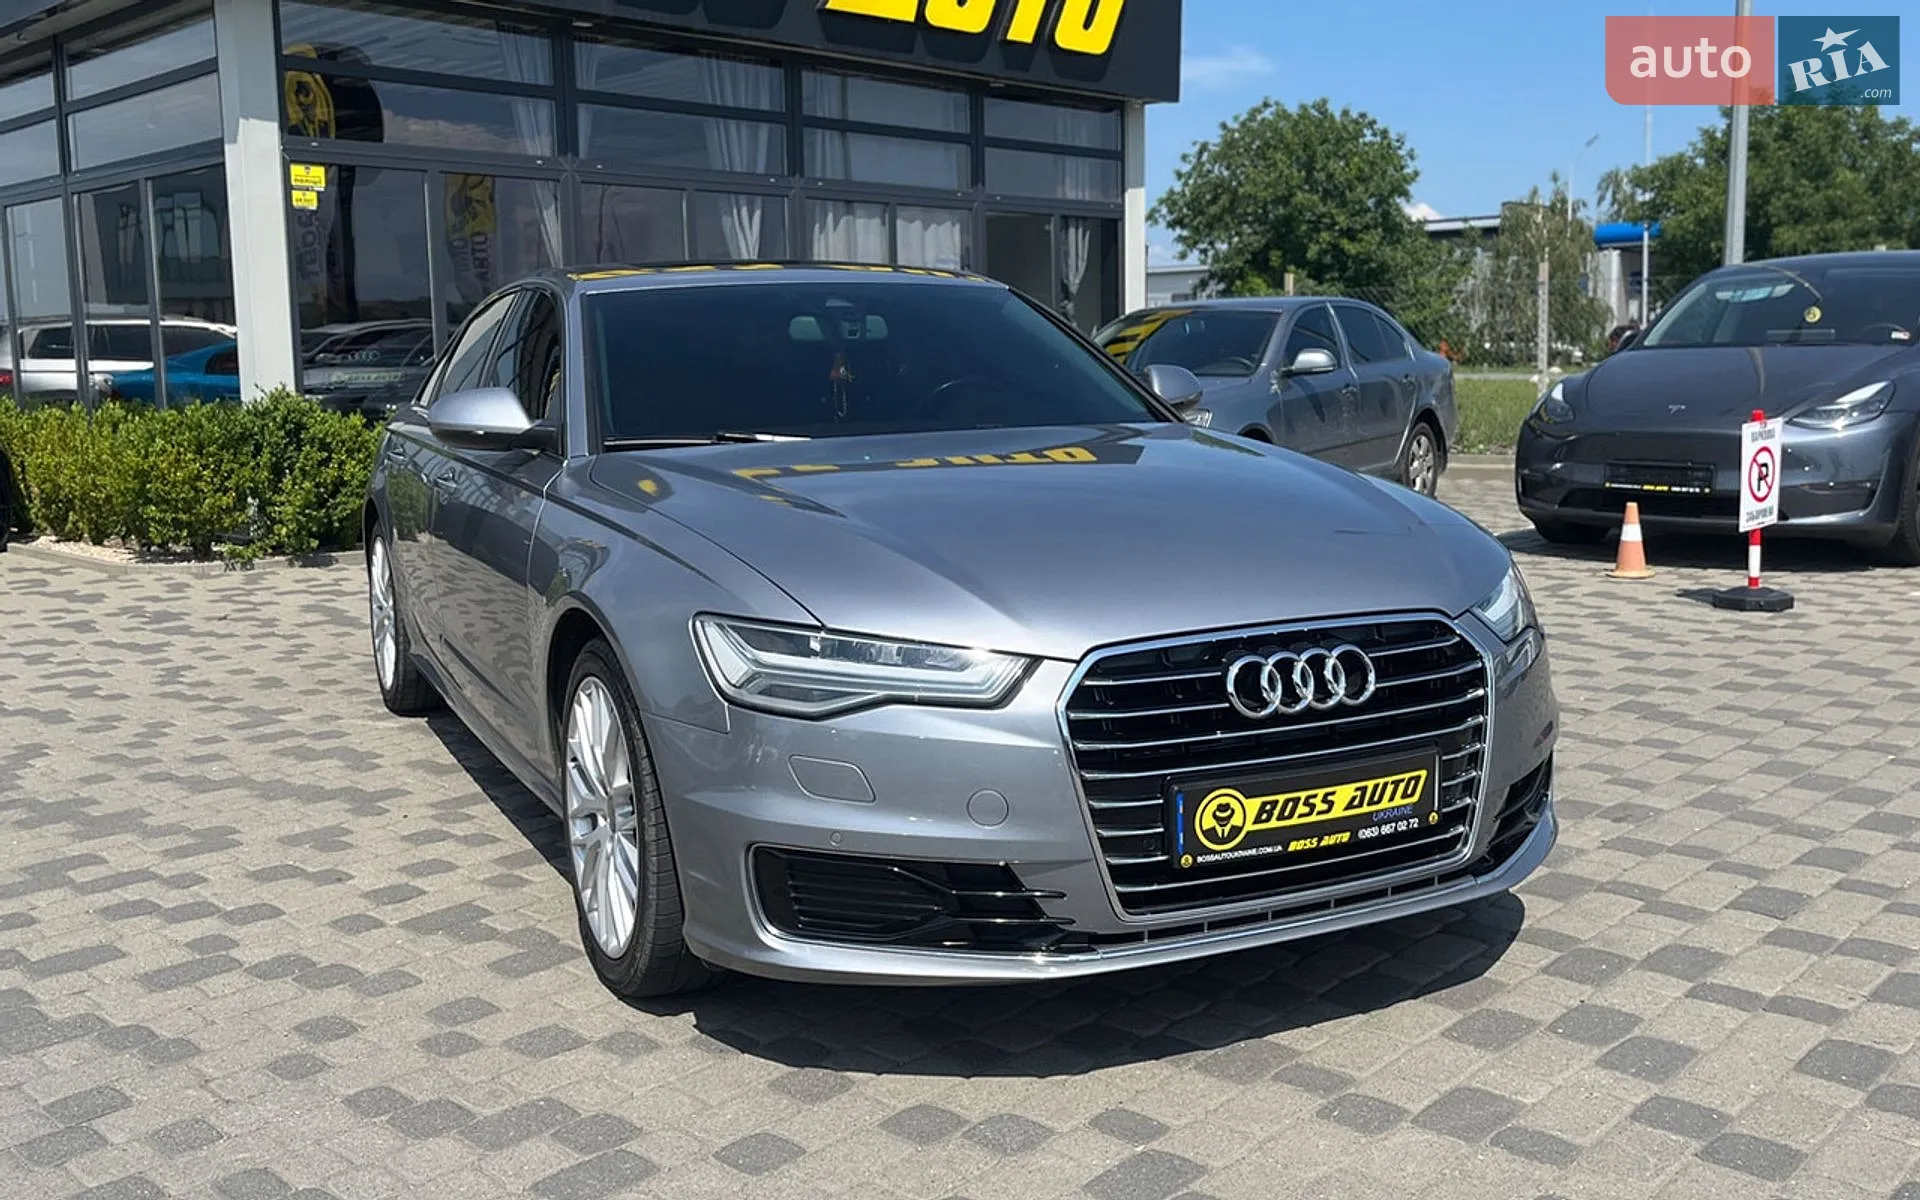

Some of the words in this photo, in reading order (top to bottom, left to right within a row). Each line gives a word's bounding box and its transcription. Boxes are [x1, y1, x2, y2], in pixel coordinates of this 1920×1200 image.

[1252, 791, 1337, 825] BOSS
[1343, 774, 1422, 812] AUTO
[1372, 805, 1414, 821] UKRAINE
[1397, 820, 1409, 831] 02
[1408, 817, 1419, 828] 72
[1287, 837, 1319, 851] BOSS
[1320, 831, 1351, 847] AUTO
